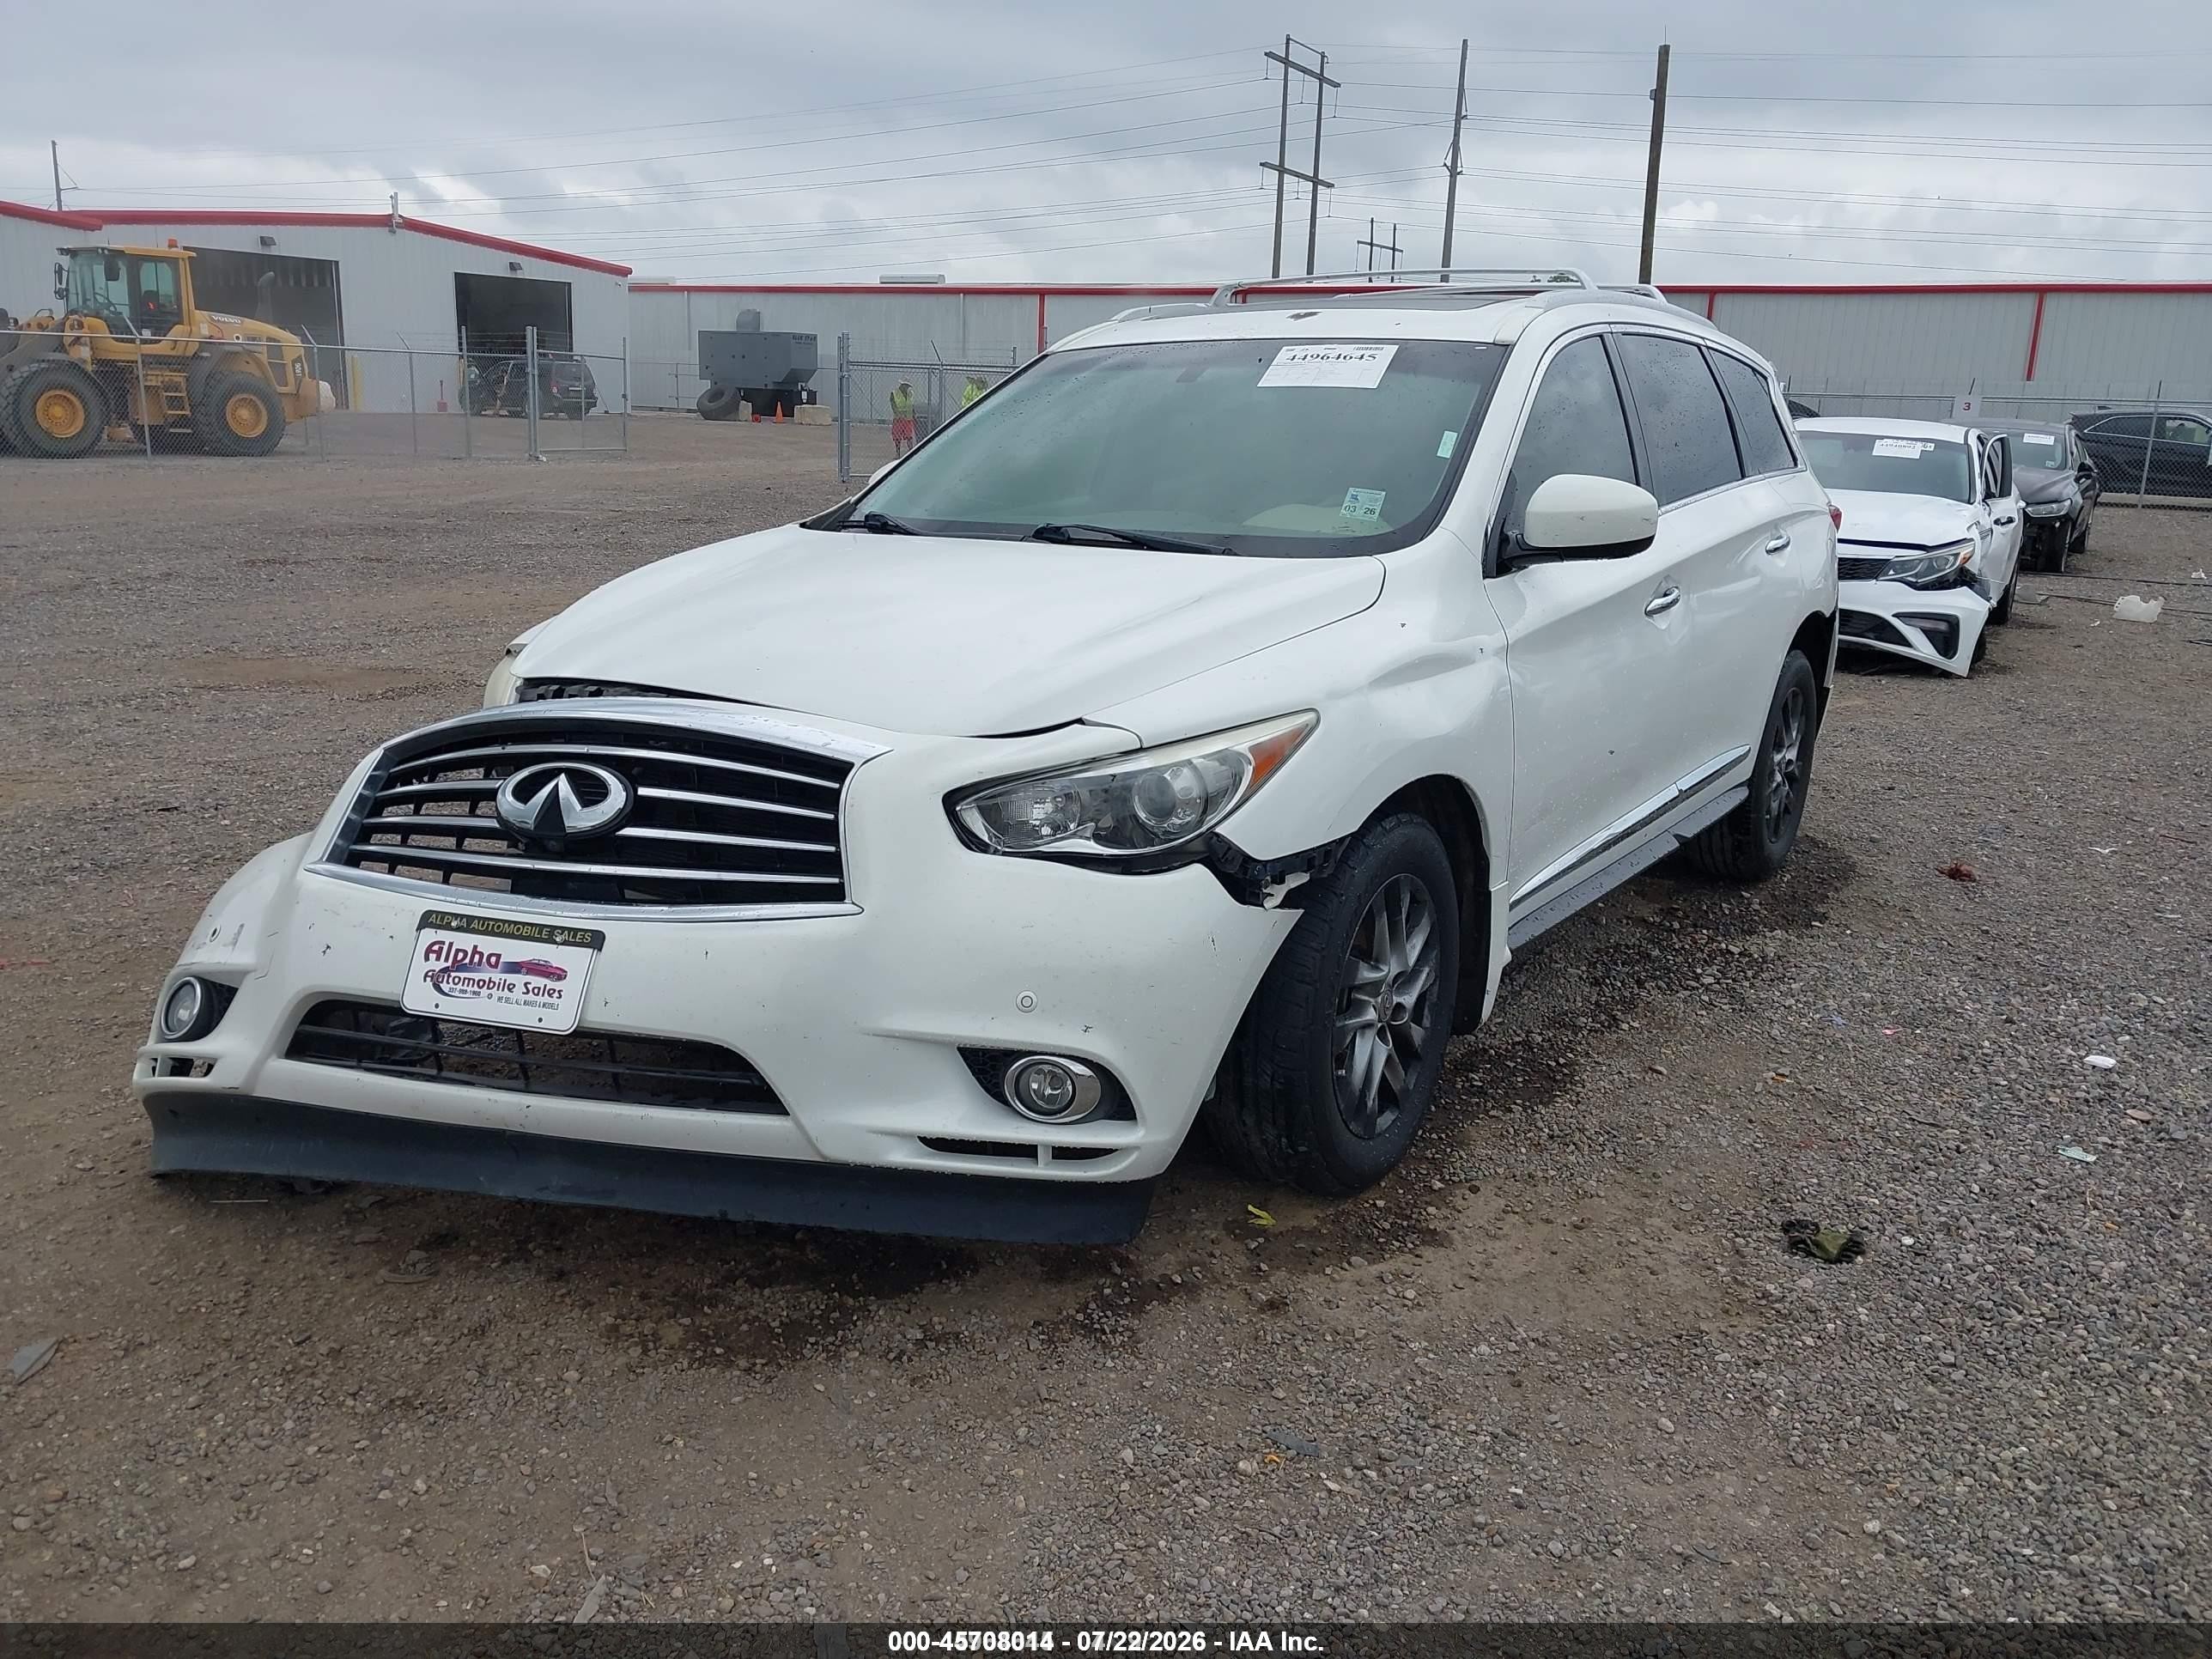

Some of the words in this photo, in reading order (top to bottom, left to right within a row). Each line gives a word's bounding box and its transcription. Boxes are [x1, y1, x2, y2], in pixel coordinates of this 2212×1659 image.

[1963, 402, 1972, 410] 3
[1344, 504, 1357, 514] 03
[1364, 507, 1376, 516] 26
[428, 913, 467, 928] ALPHA
[469, 921, 550, 939] AUTOMOBILE
[553, 928, 592, 944] SALES
[424, 939, 502, 970] Alpha
[422, 969, 516, 994] Automobile
[521, 981, 564, 1000] Sales
[504, 996, 514, 1005] SELL
[523, 999, 538, 1008] MAKES
[542, 1001, 560, 1011] MODELS
